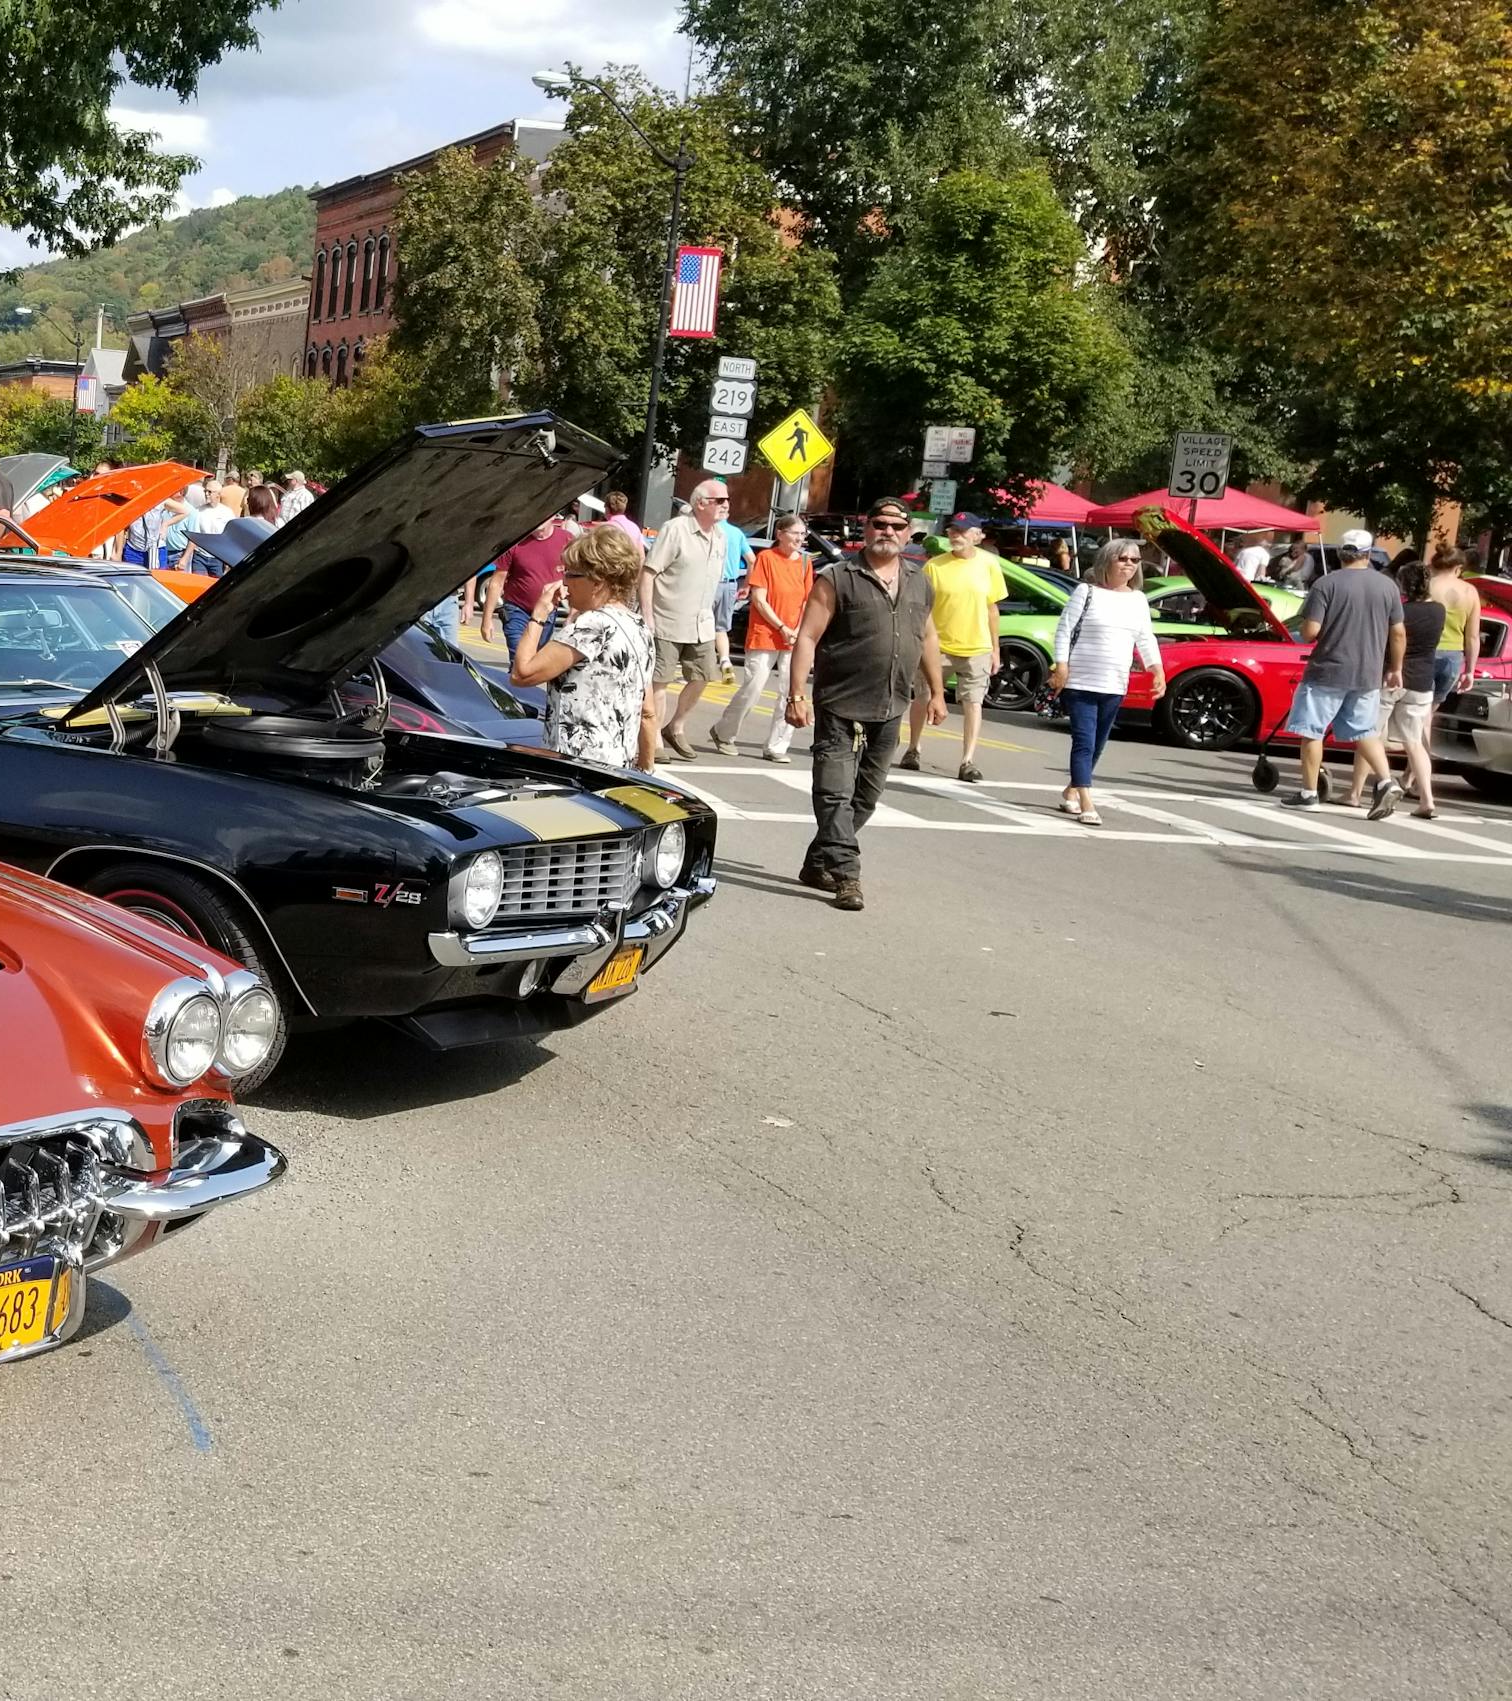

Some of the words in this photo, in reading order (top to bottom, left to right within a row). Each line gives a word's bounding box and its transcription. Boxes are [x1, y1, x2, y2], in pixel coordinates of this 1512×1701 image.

[722, 362, 751, 375] NORTH
[717, 388, 748, 407] 219
[713, 421, 743, 433] EAST
[1181, 436, 1228, 446] VILLAGE
[707, 447, 741, 467] 242
[1183, 447, 1222, 457] SPEED
[1185, 459, 1217, 468] LIMIT
[1176, 470, 1220, 495] 30
